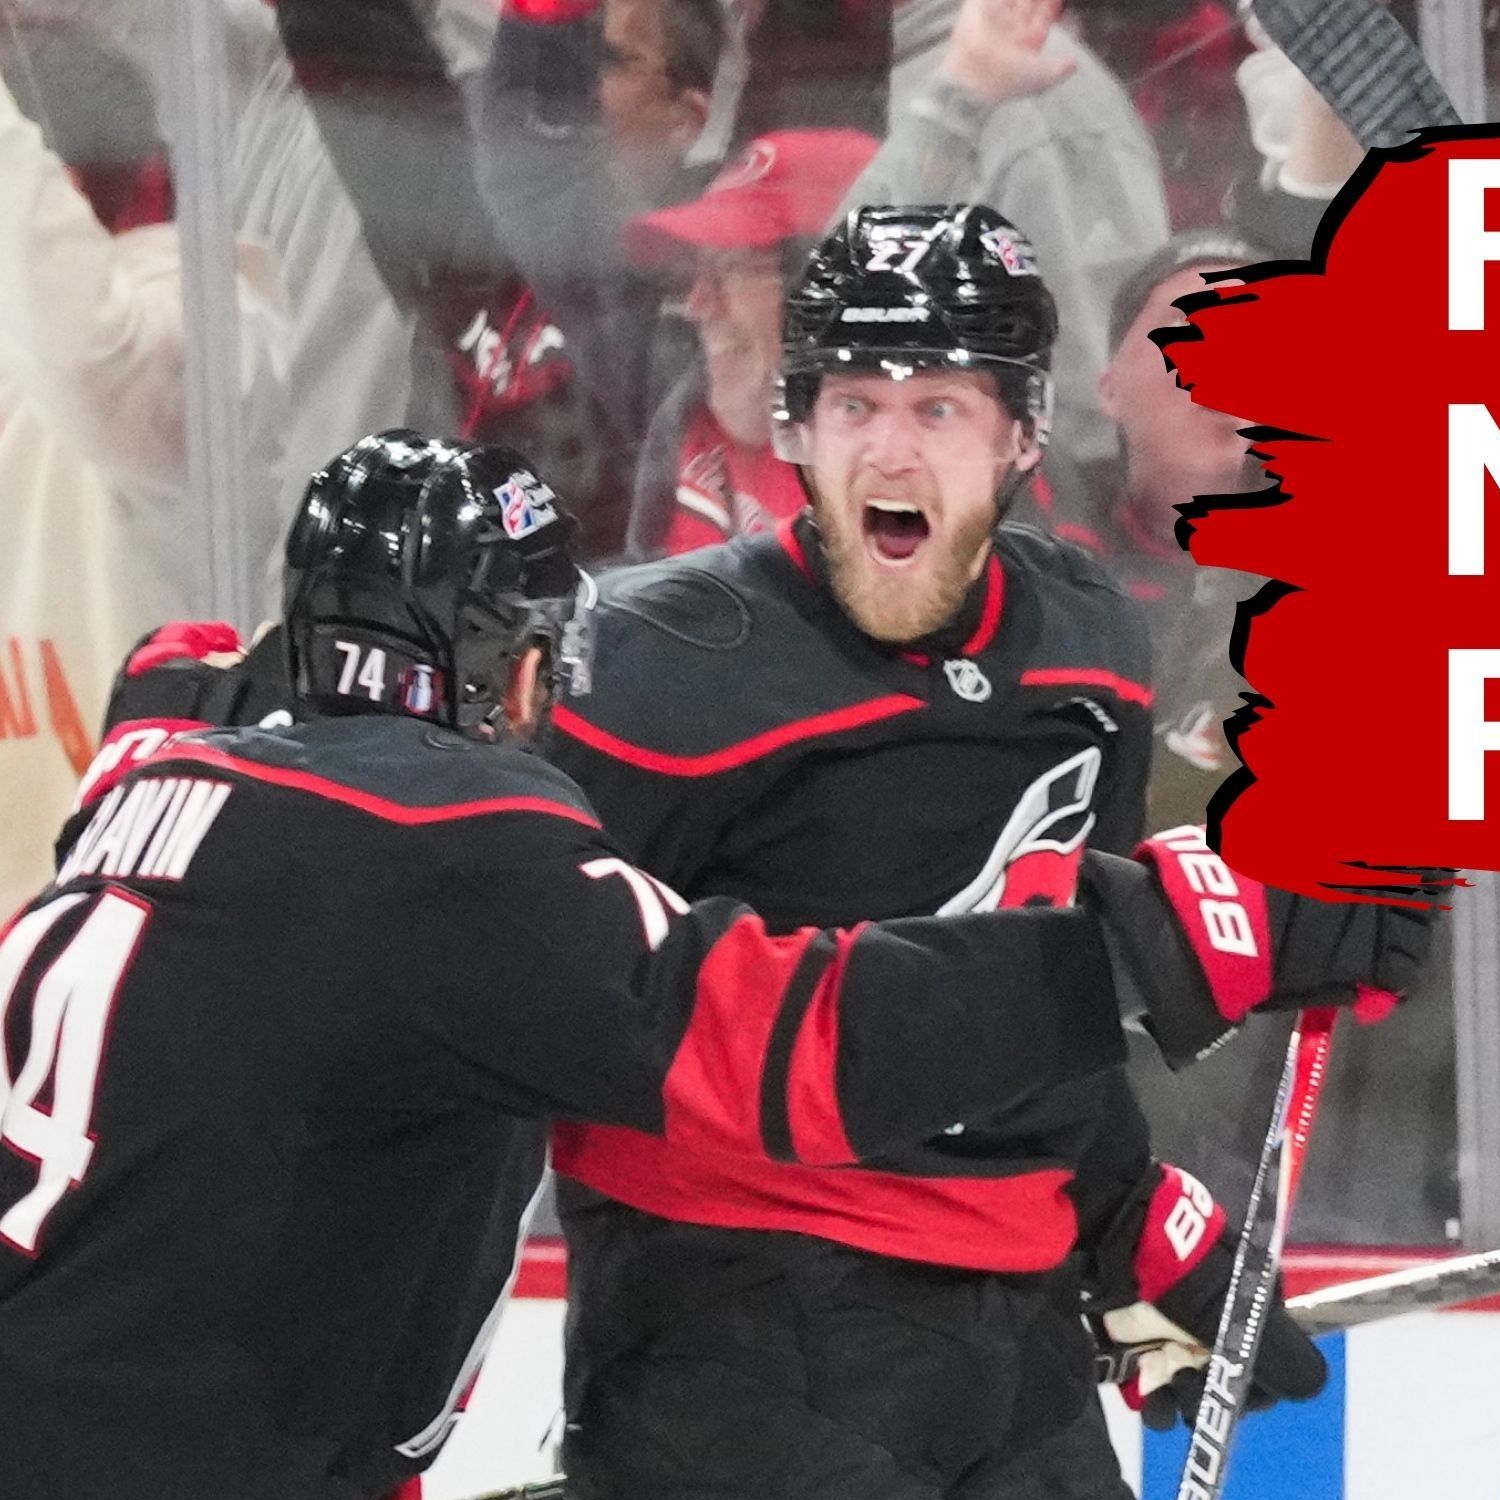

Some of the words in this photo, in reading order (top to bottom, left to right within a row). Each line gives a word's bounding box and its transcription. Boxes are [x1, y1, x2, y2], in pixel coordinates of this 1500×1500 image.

[866, 240, 930, 273] 27
[335, 640, 386, 701] 74
[577, 856, 692, 953] 7
